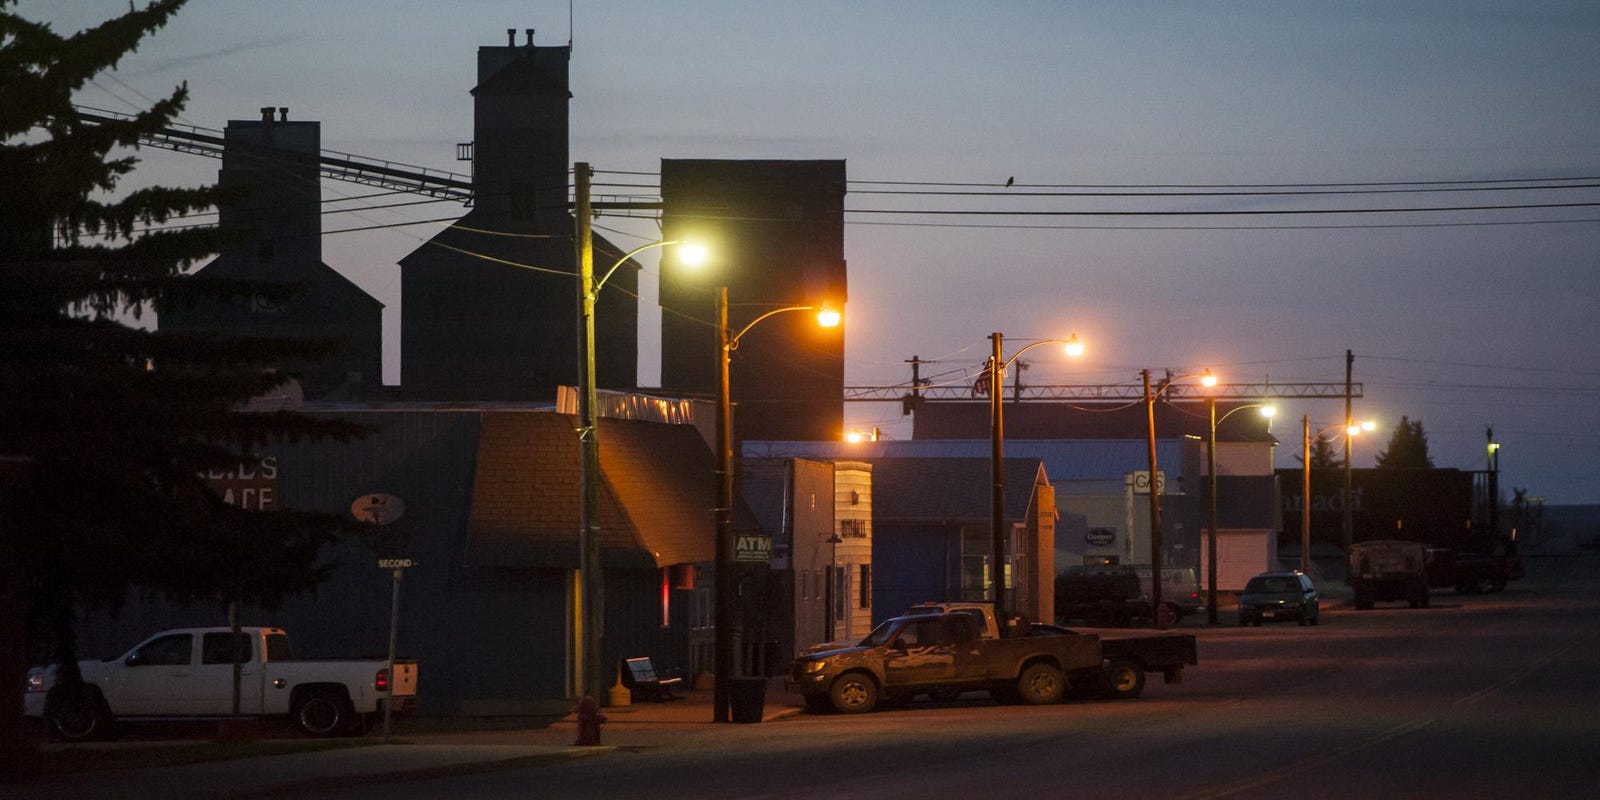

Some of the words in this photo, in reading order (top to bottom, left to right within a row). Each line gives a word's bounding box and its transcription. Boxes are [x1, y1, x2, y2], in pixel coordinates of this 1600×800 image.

[1280, 487, 1362, 512] anada
[736, 536, 772, 551] ATM
[377, 558, 413, 568] SECOND
